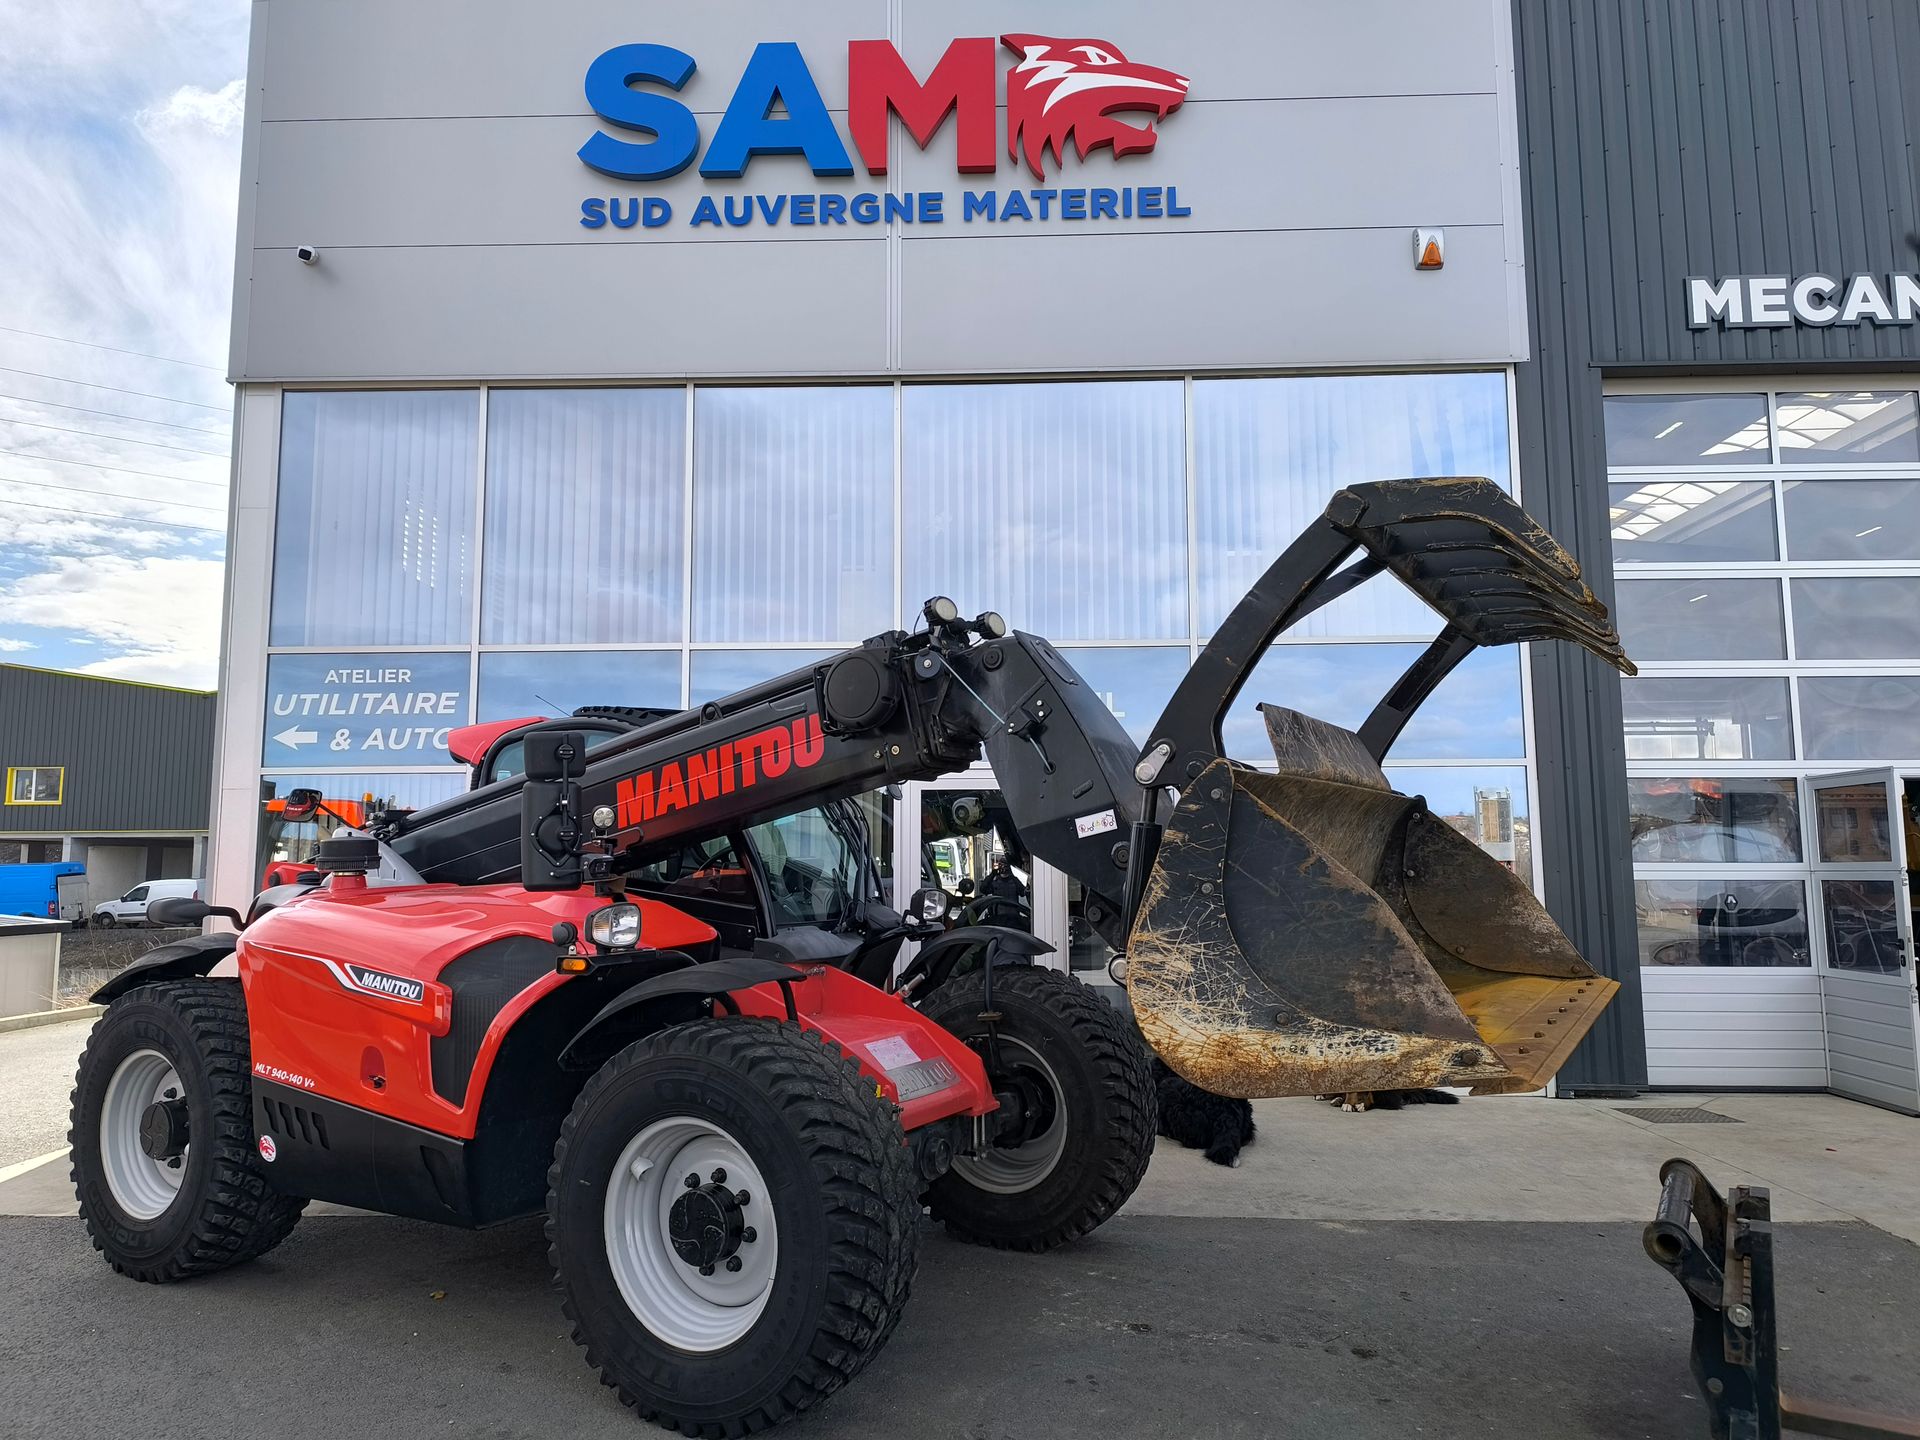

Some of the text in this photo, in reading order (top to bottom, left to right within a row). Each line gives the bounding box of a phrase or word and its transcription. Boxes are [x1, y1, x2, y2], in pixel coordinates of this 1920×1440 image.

[577, 38, 996, 181] SAM
[580, 186, 1191, 229] SUD AUVERGNE MATERIEL
[324, 669, 411, 684] ATELIER
[273, 692, 460, 716] UTILITAIRE
[329, 728, 352, 751] &
[616, 713, 825, 829] MANITOU
[361, 972, 420, 999] MANITOU
[254, 1062, 316, 1088] MLT 940-140 V+
